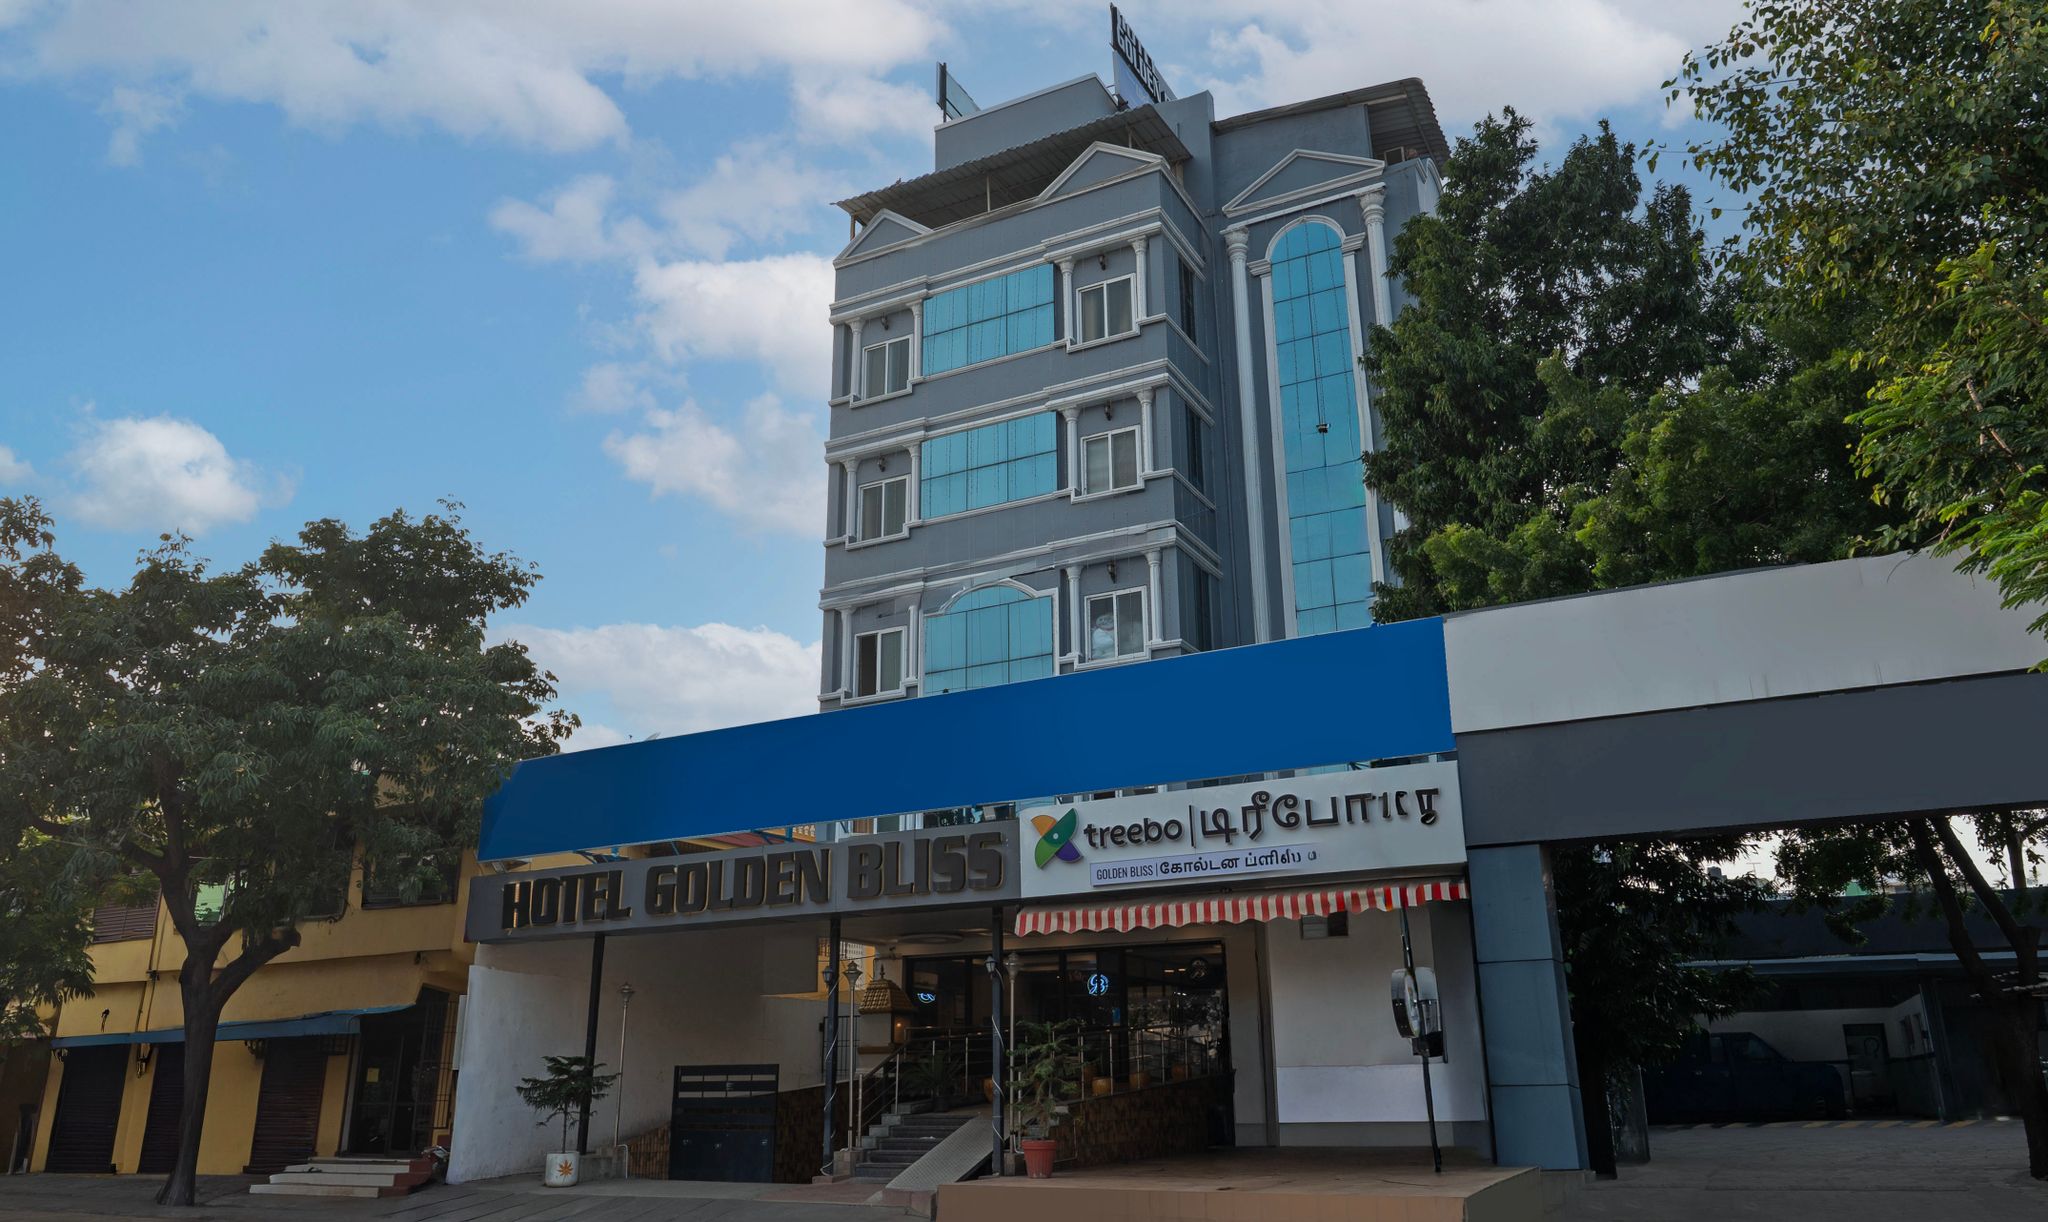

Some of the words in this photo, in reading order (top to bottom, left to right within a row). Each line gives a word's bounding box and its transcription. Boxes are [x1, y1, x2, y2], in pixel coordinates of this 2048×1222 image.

[1118, 33, 1161, 103] GOLDEN
[1083, 817, 1184, 847] treebo
[502, 870, 632, 929] HOTEL
[645, 848, 831, 915] GOLDEN
[847, 832, 1003, 898] BLISS
[1096, 868, 1128, 881] GOLDEN
[1130, 865, 1153, 878] BLISS
